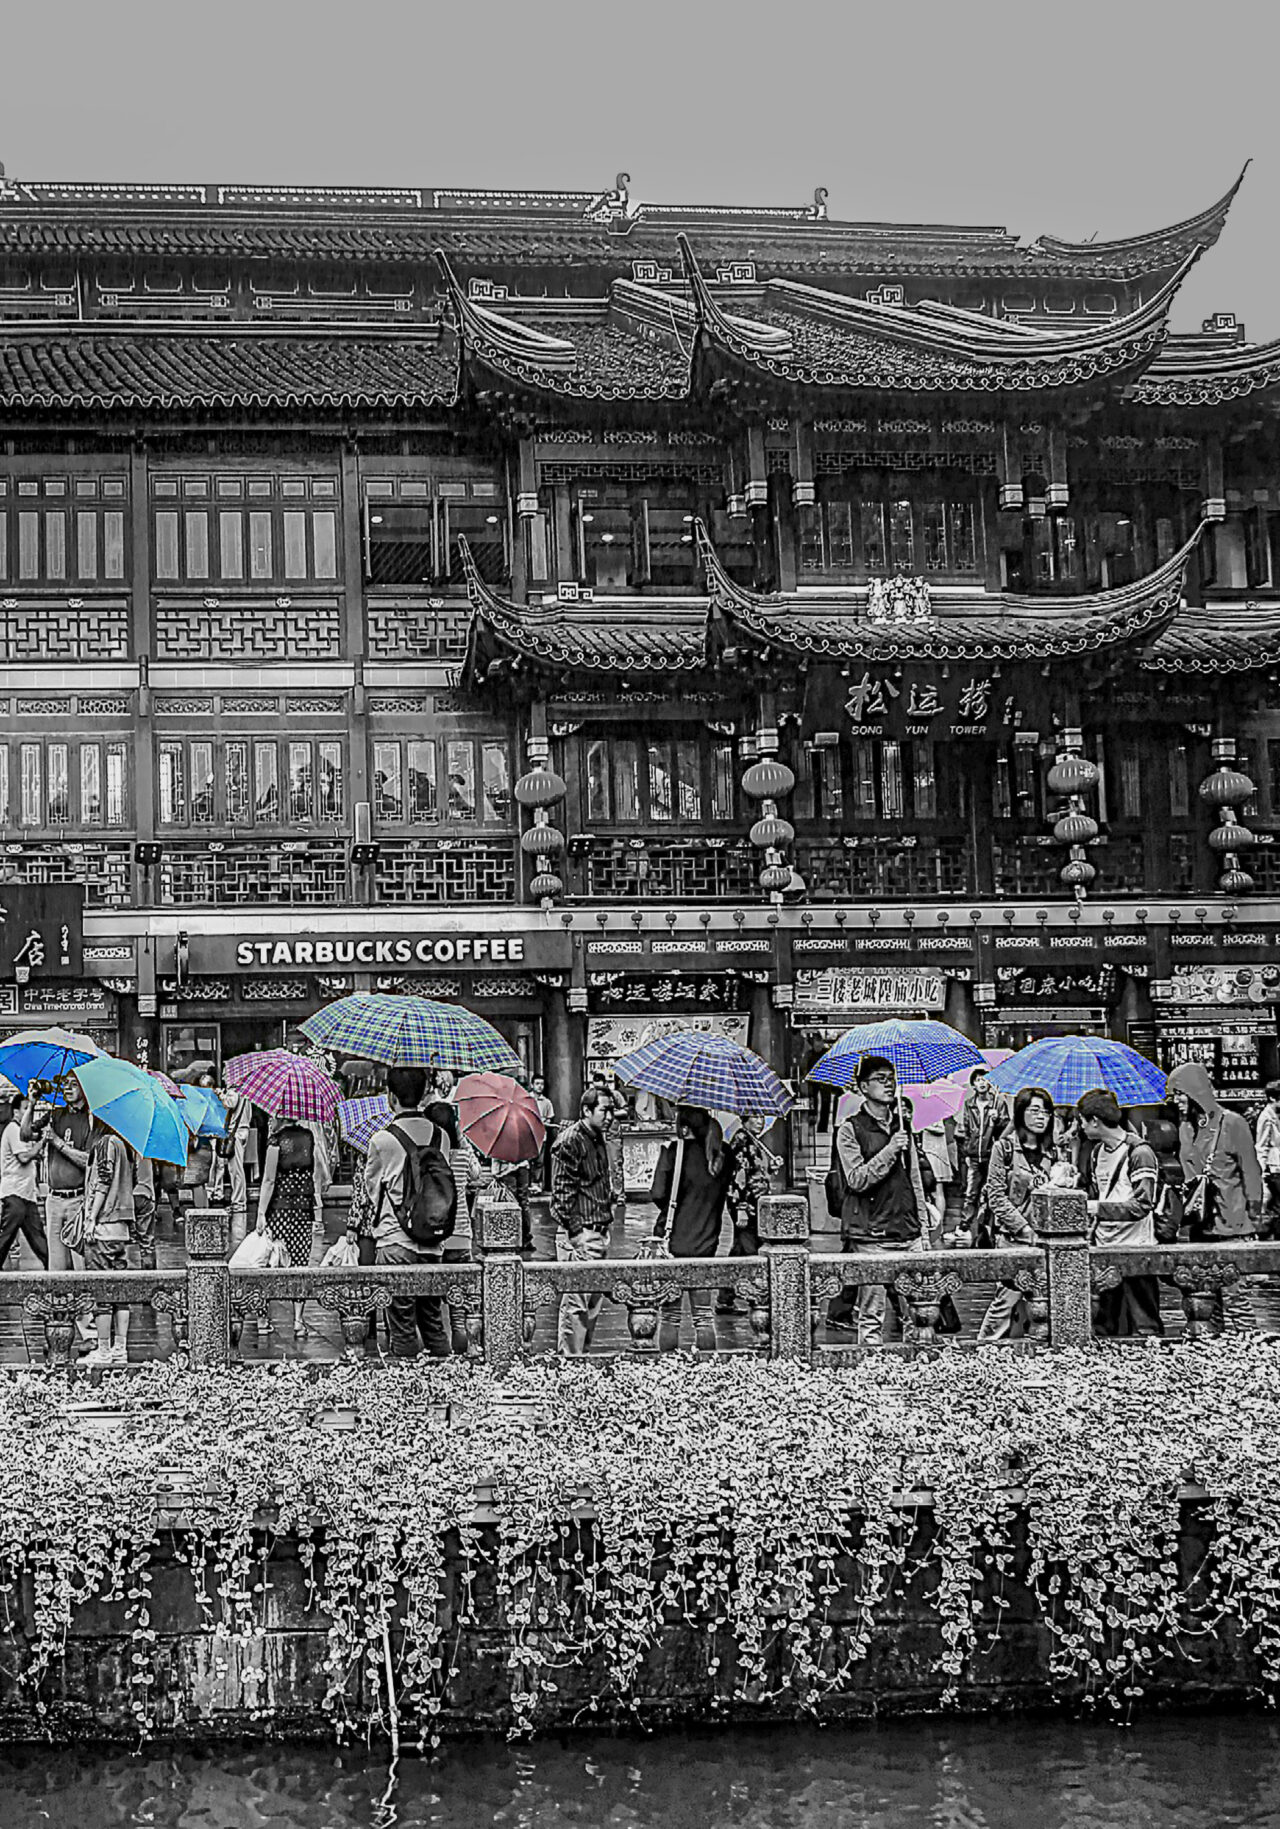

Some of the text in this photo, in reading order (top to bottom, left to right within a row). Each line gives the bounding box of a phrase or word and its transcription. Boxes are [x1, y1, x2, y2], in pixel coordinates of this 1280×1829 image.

[851, 725, 987, 735] SONG YUN TOWER
[237, 938, 524, 965] STARBUCKS COFFEE
[24, 988, 105, 1002] 中华老字号
[24, 1002, 43, 1011] China
